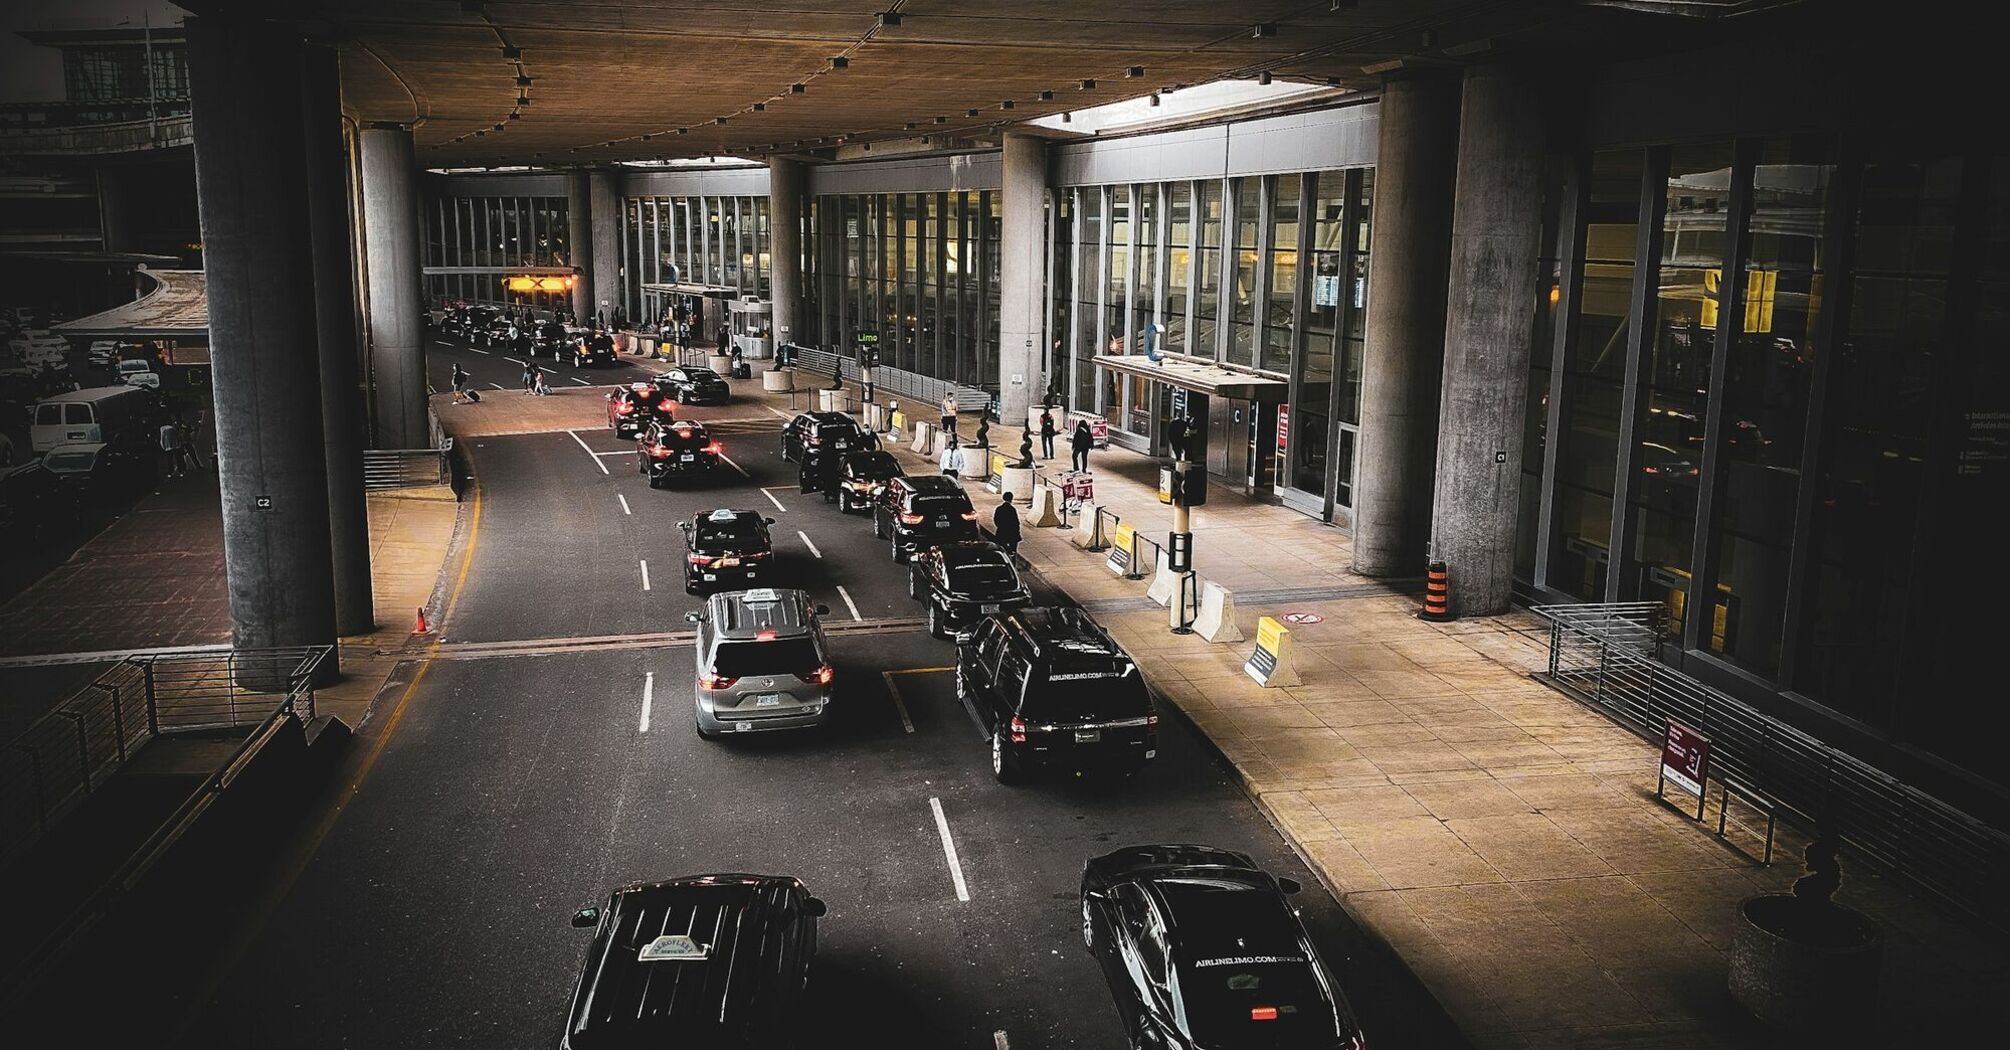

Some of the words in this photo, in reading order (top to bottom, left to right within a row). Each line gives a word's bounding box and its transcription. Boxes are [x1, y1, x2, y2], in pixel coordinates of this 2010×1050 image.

[857, 333, 878, 342] Limo
[1234, 409, 1240, 423] C
[257, 498, 270, 507] C2
[1195, 955, 1278, 968] AIRLINELIMO.COM
